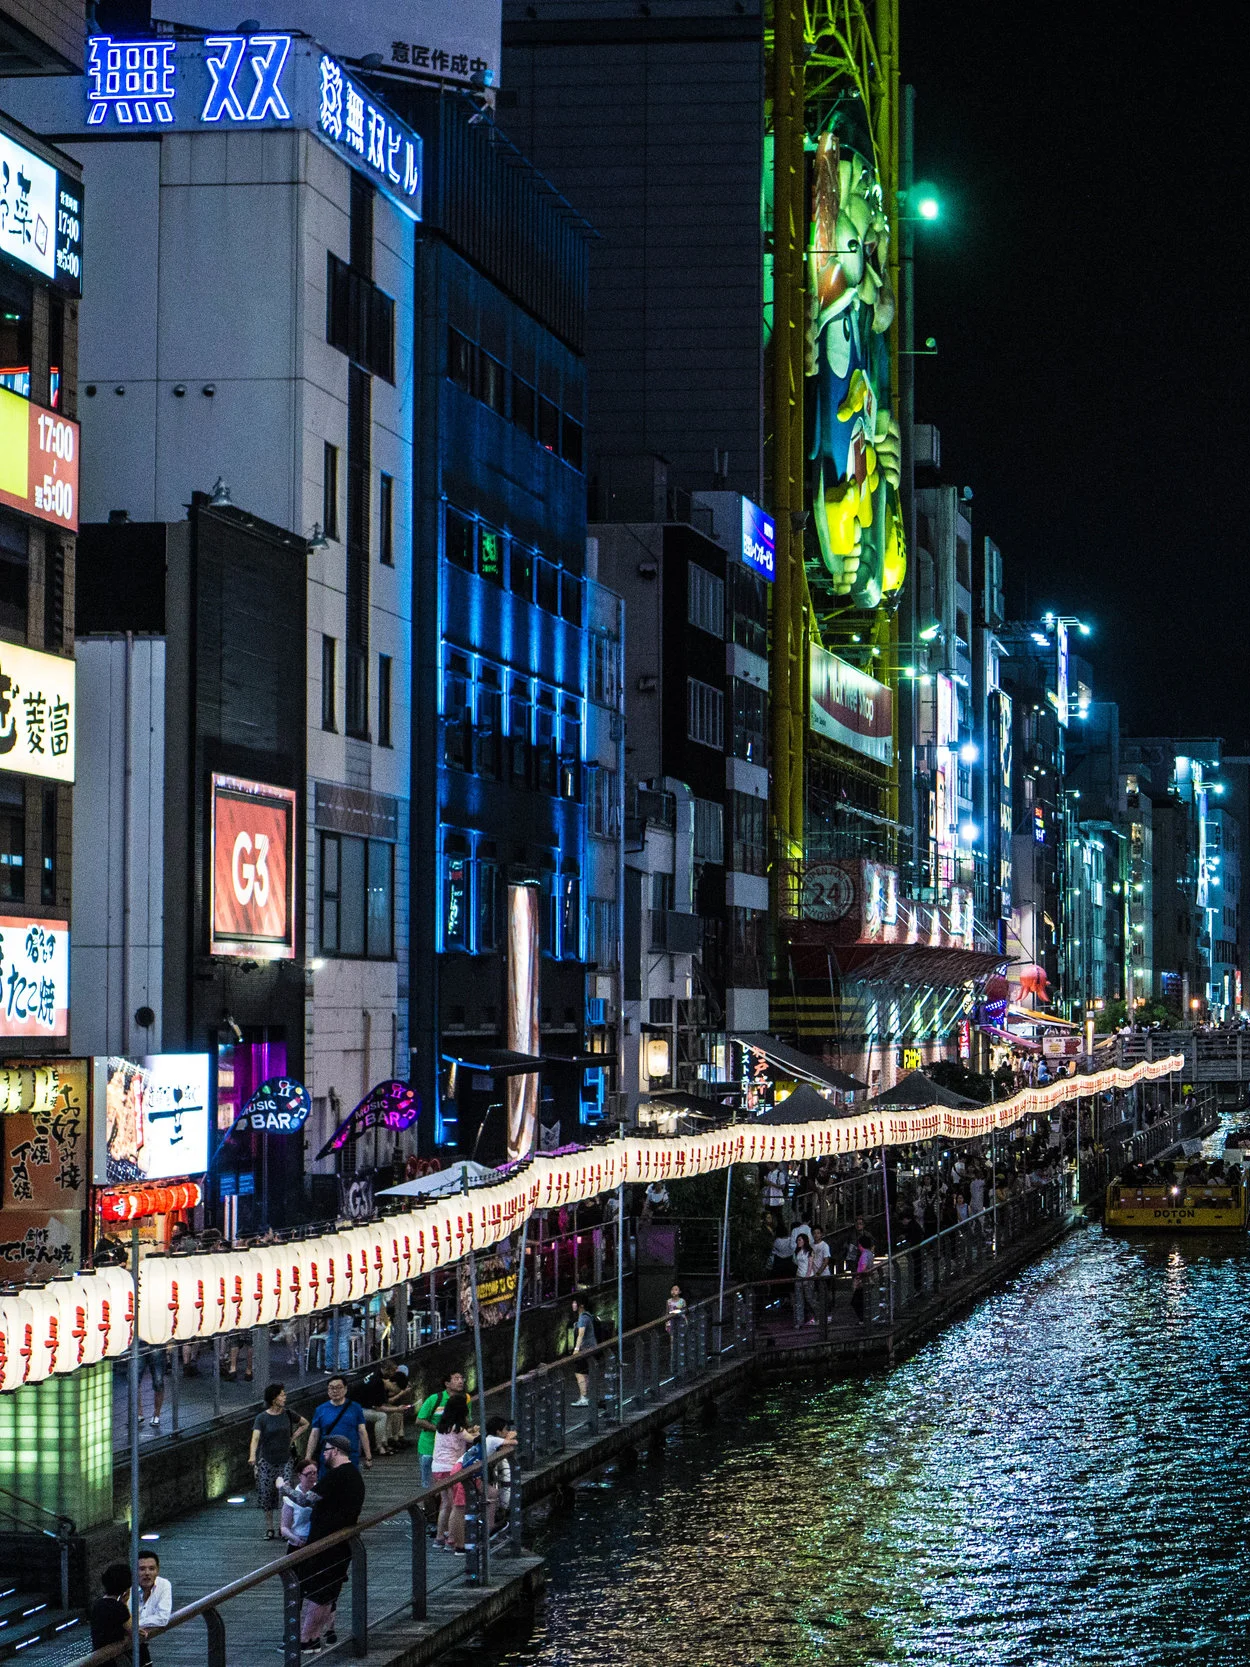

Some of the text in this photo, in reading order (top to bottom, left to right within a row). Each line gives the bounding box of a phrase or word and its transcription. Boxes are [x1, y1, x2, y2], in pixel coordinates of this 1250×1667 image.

[391, 41, 487, 76] 意匠作成中
[87, 35, 290, 124] 無双
[58, 210, 79, 242] 17:00
[38, 414, 73, 461] 17:00
[35, 474, 73, 520] 翌5:00
[231, 831, 270, 908] G3
[813, 882, 841, 906] 24
[7, 963, 56, 1025] たこ焼
[242, 1099, 277, 1115] MUSIC
[251, 1112, 291, 1129] BAR
[355, 1100, 389, 1119] MUSIC
[365, 1111, 400, 1128] BAR
[50, 1083, 84, 1190] お好み焼
[11, 1142, 32, 1201] イカ焼
[1154, 1210, 1195, 1218] DOTON
